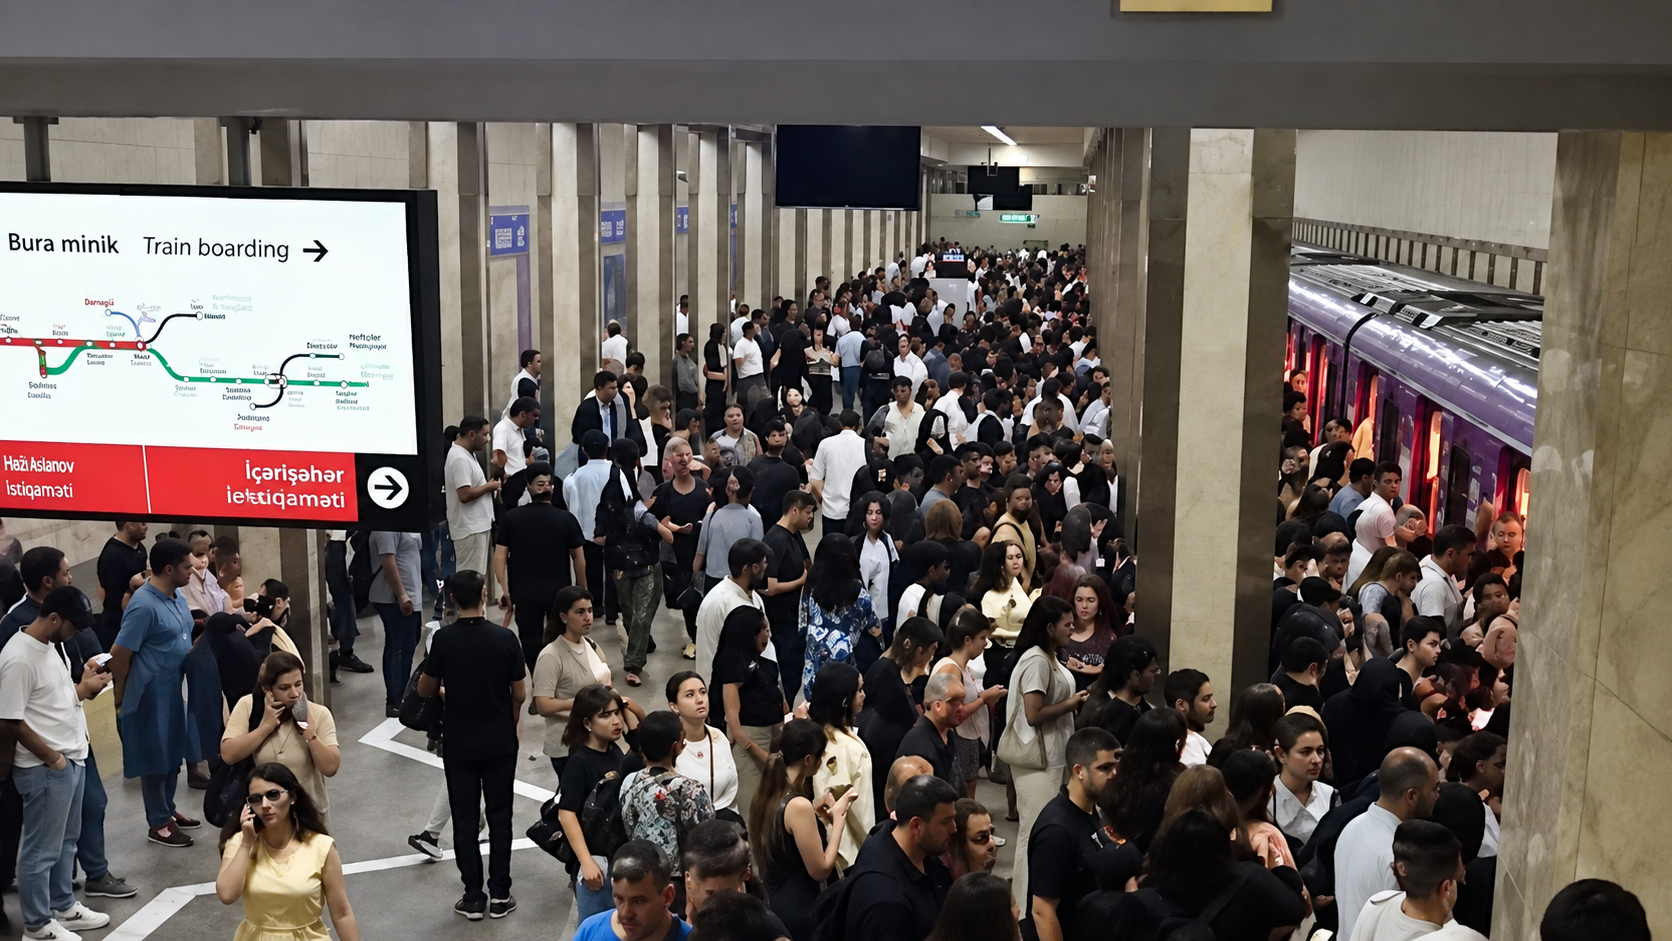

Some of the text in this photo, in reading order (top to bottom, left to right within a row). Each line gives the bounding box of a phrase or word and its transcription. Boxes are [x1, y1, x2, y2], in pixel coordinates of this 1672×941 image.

[8, 232, 289, 263] Bura minik Train boarding
[30, 455, 75, 473] Aslanov
[245, 459, 345, 486] İçərişəhər
